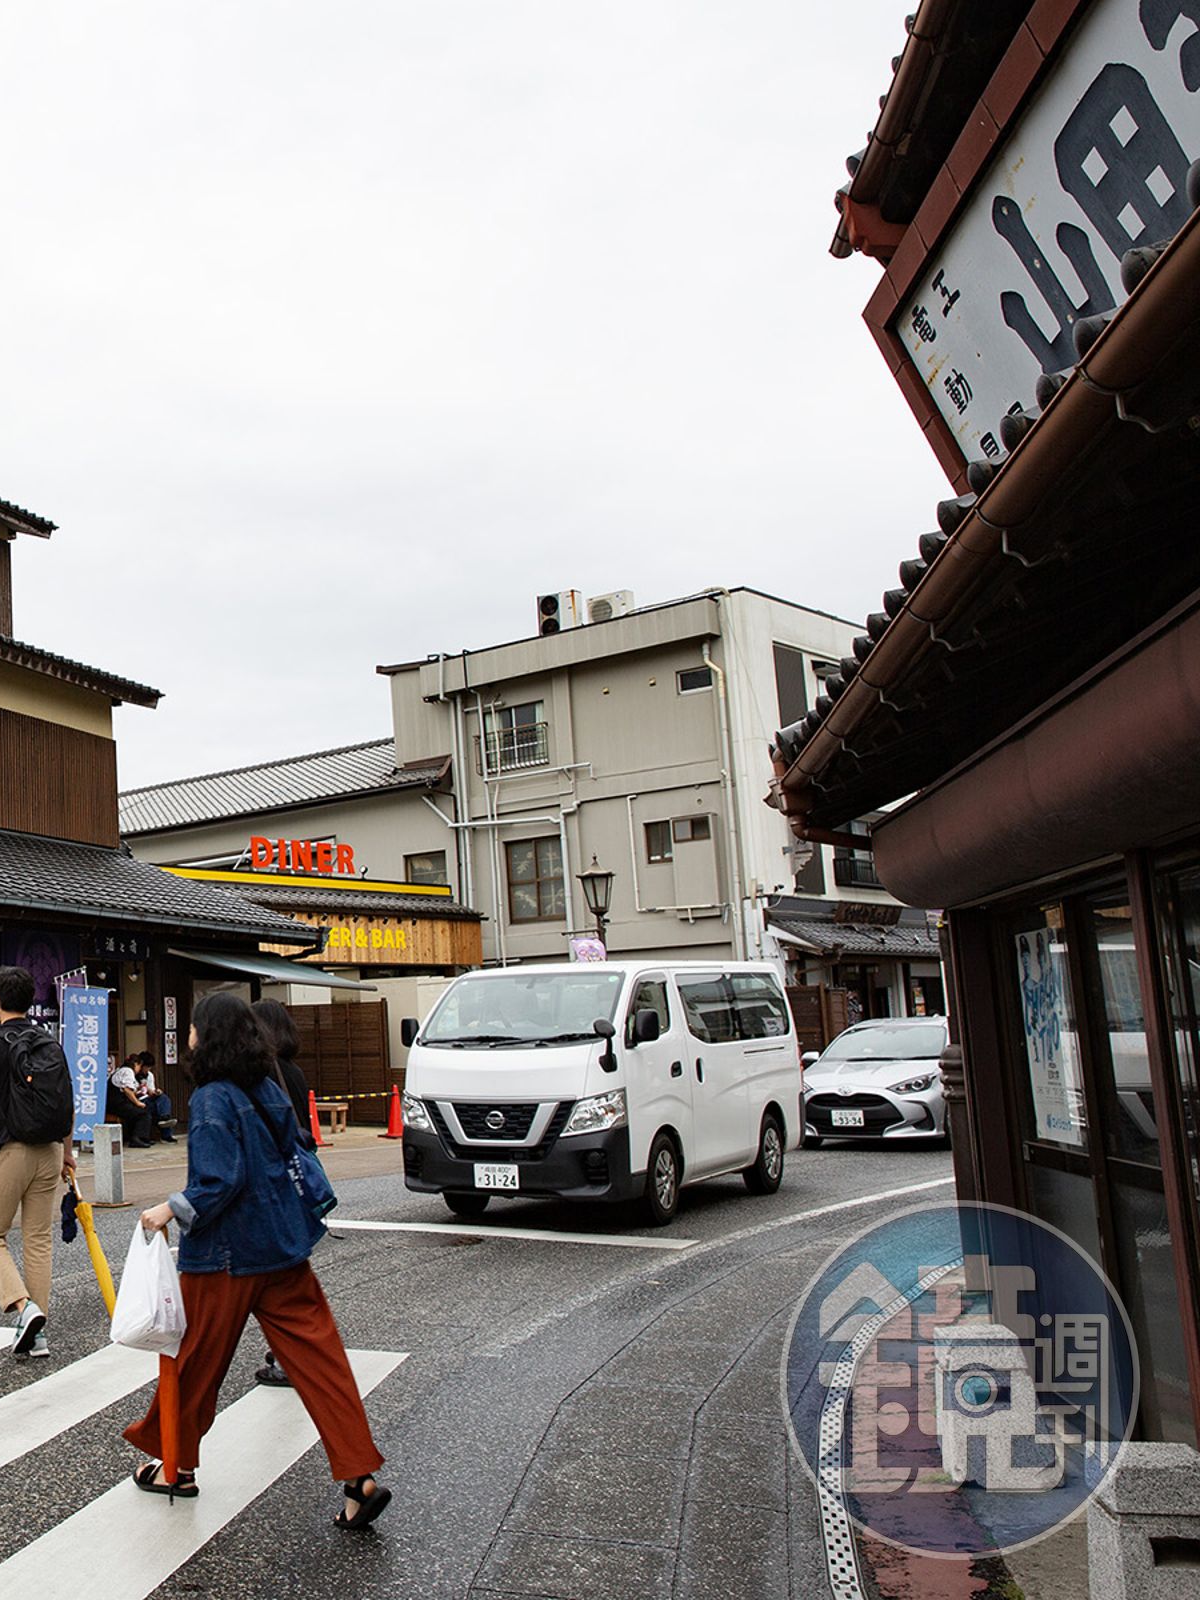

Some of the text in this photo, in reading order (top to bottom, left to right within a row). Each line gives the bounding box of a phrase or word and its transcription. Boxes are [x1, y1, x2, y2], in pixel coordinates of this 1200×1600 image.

[250, 835, 355, 874] DINER
[326, 927, 407, 949] ER & BAR
[69, 994, 106, 1006] 成田名物
[75, 1014, 99, 1115] 酒蔵の甘酒
[484, 1174, 516, 1187] 31-24
